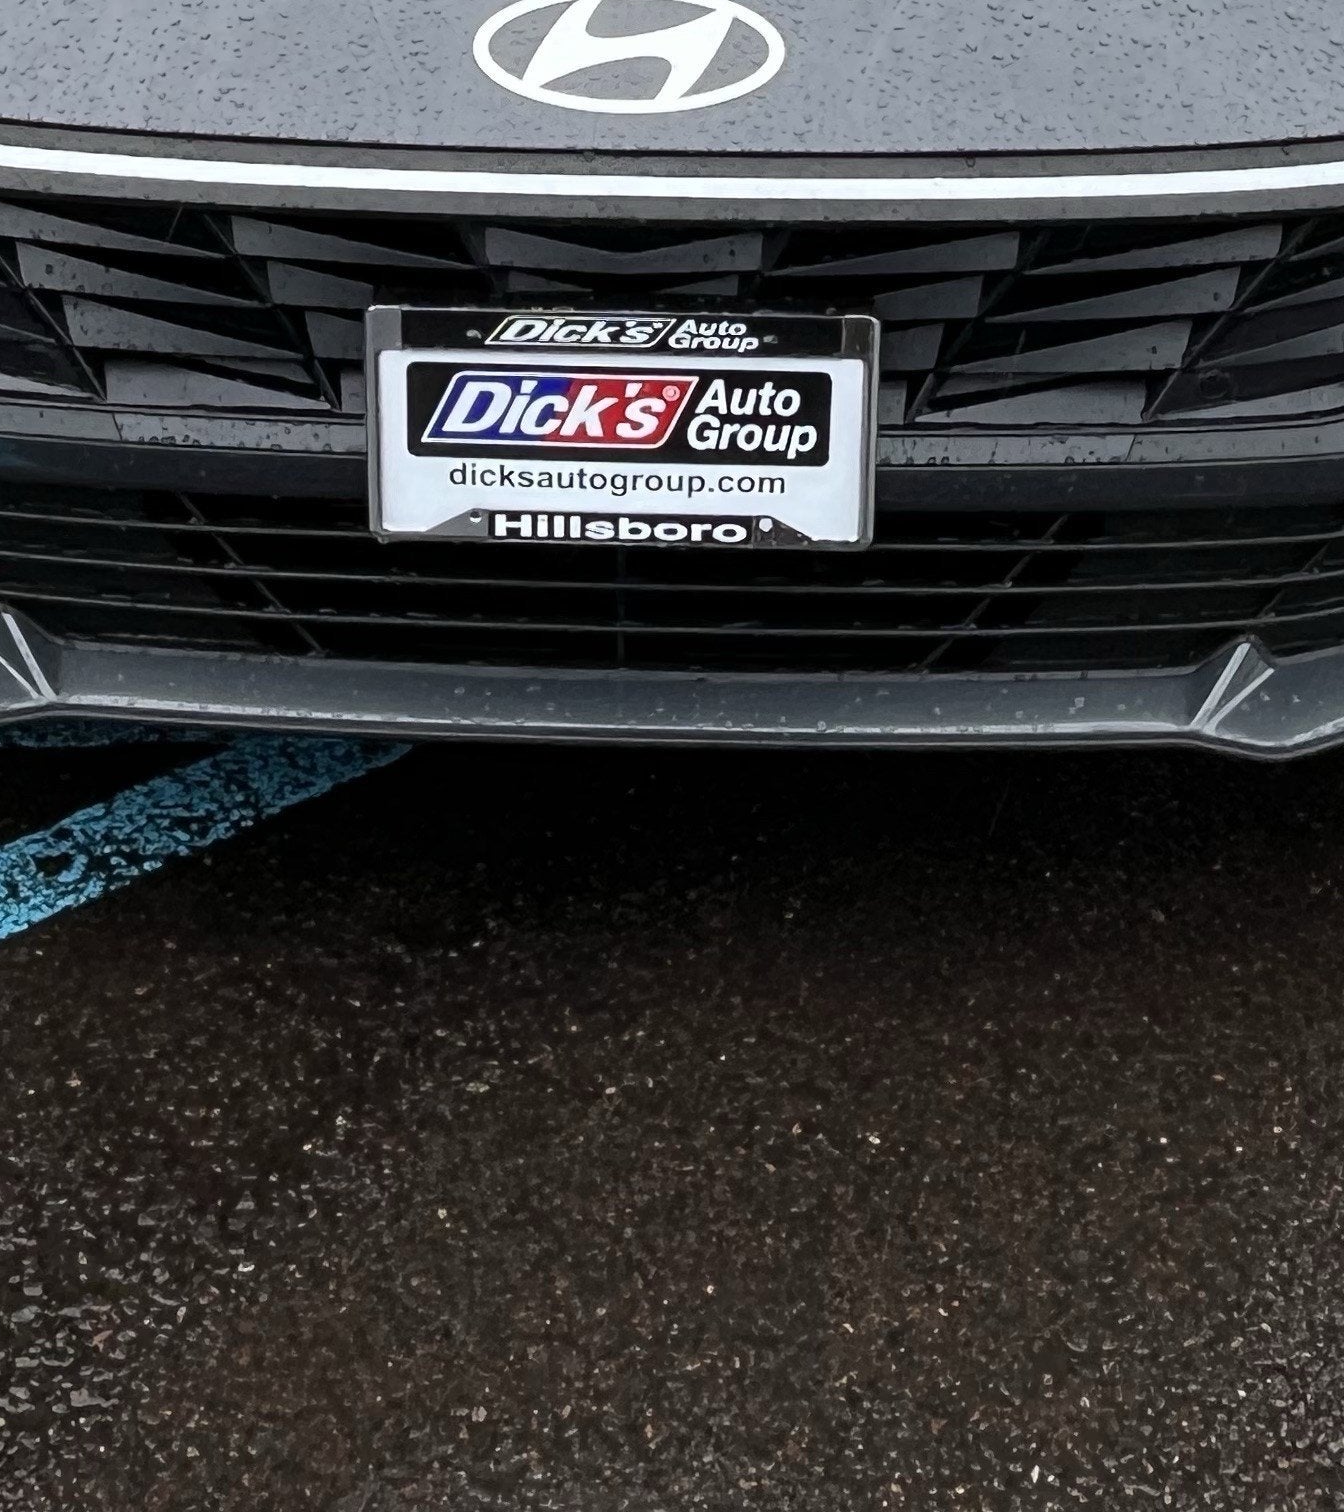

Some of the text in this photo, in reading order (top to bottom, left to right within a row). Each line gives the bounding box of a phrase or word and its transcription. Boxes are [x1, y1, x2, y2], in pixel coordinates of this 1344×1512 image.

[498, 318, 747, 344] Dick's Auto
[668, 335, 760, 353] Group
[441, 378, 801, 439] Dick's Auto
[686, 414, 818, 460] Group
[449, 463, 785, 498] dicksautogroup.com
[494, 514, 747, 543] Hillsboro
